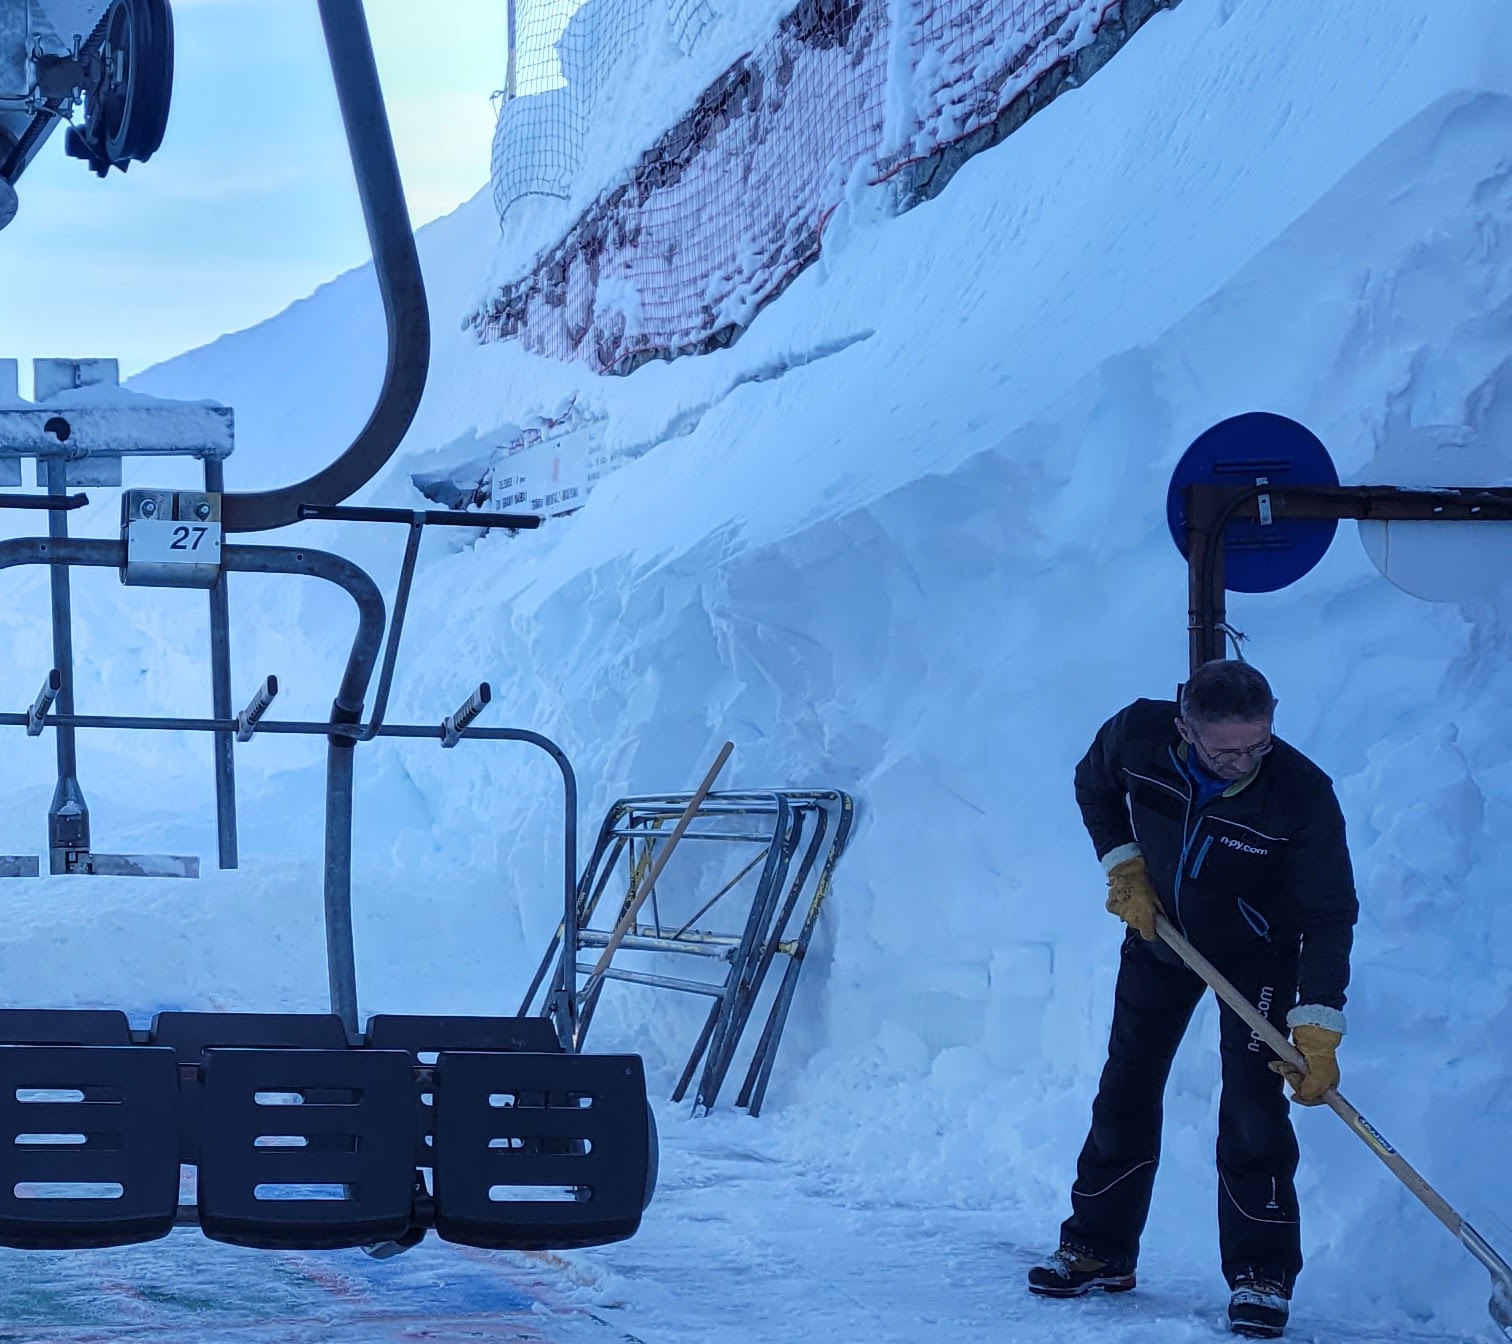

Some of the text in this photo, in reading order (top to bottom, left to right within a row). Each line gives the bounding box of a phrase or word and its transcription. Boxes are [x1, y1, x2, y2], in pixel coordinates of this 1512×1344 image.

[170, 526, 208, 550] 27
[1220, 836, 1268, 855] n-py.com
[1247, 986, 1275, 1052] n-pcom
